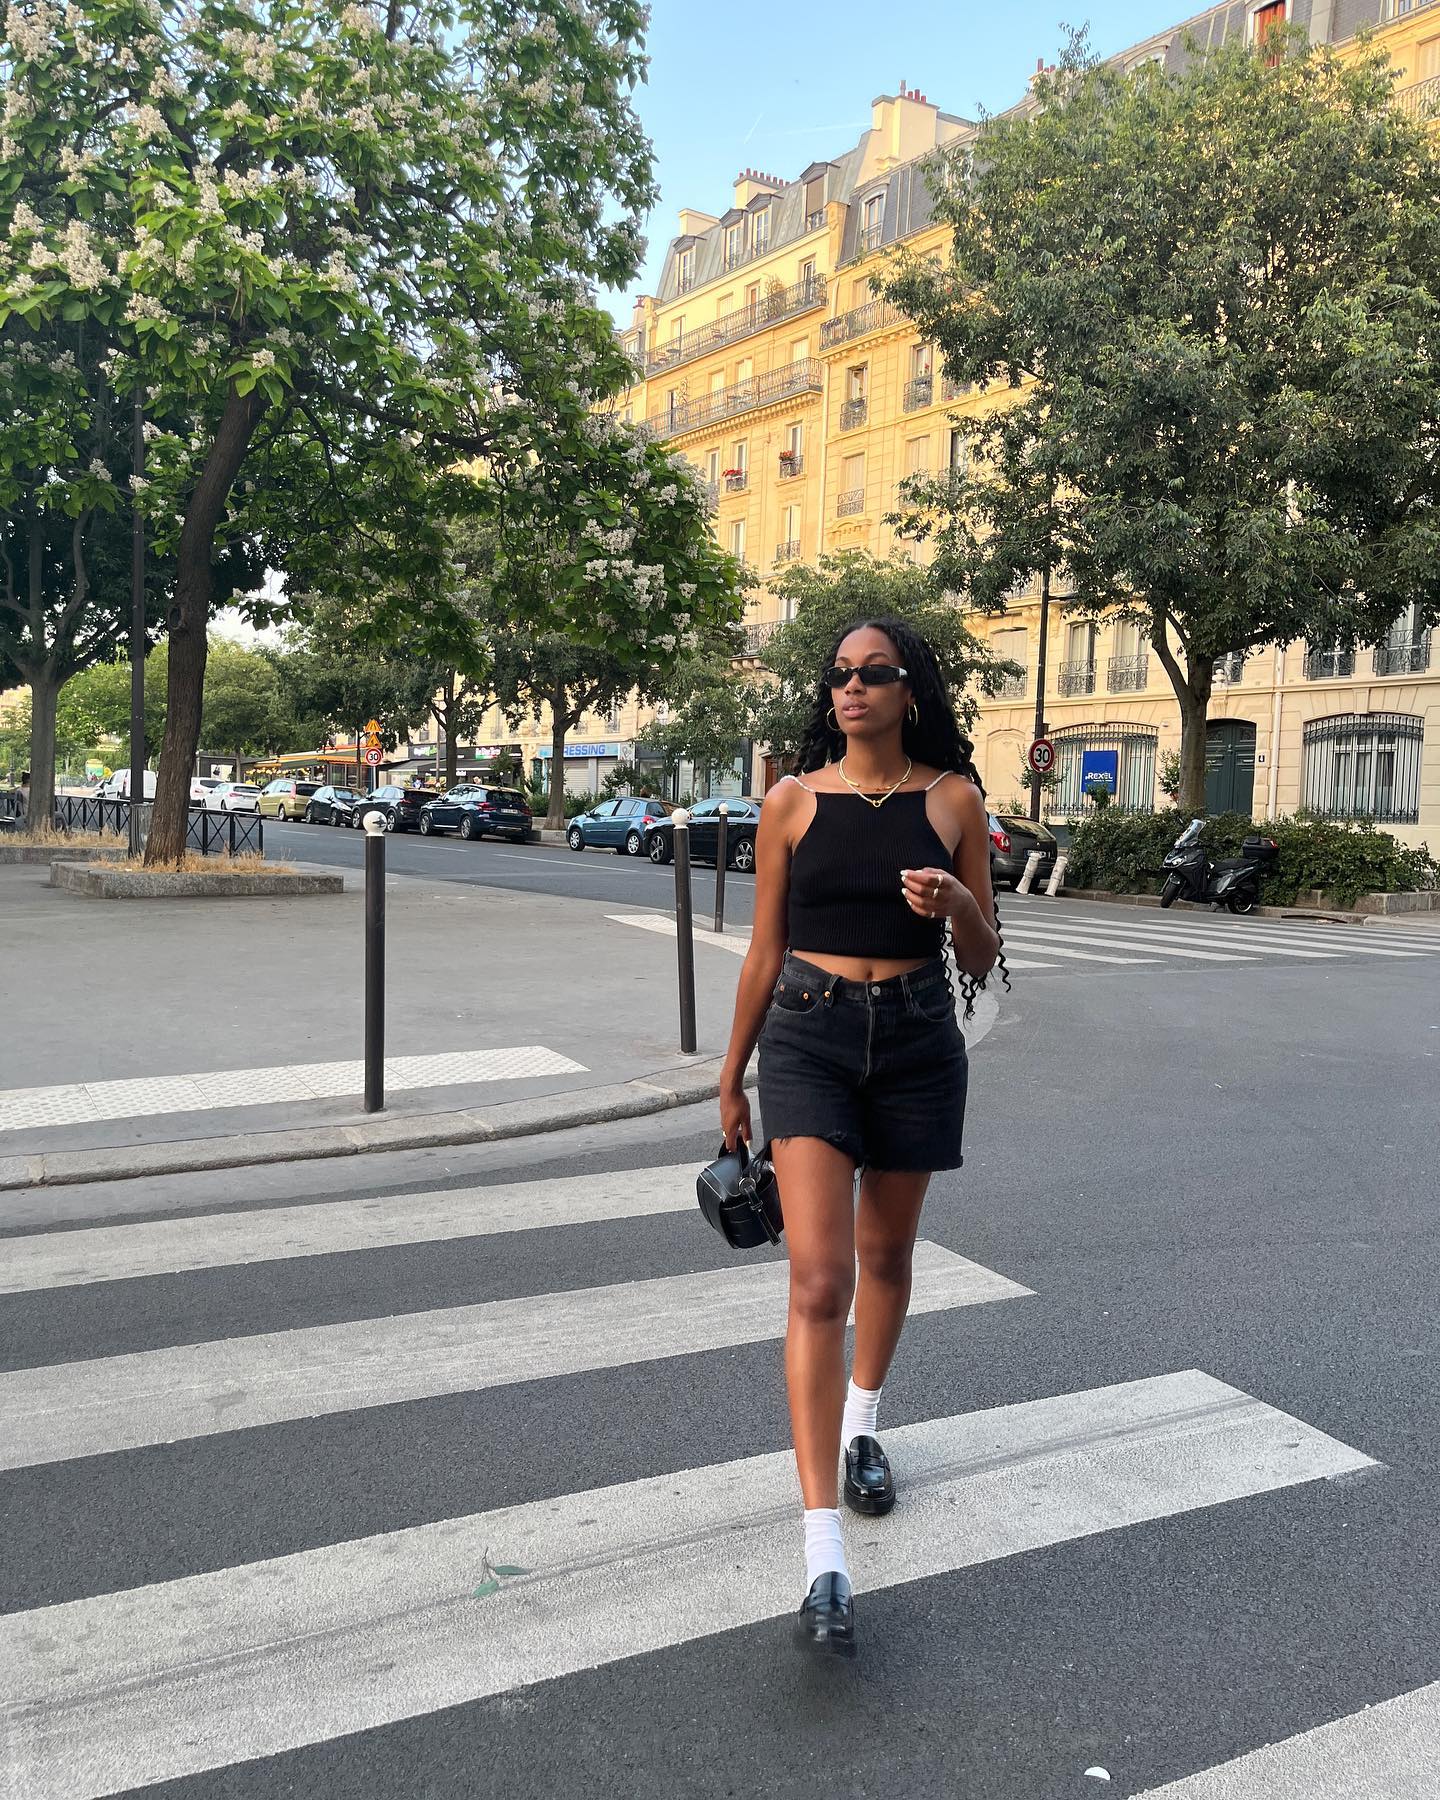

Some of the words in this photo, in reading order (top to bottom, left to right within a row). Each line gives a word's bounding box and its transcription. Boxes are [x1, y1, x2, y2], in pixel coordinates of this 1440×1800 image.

[564, 744, 606, 756] RESSING
[1034, 747, 1050, 764] 30
[369, 752, 379, 761] 30
